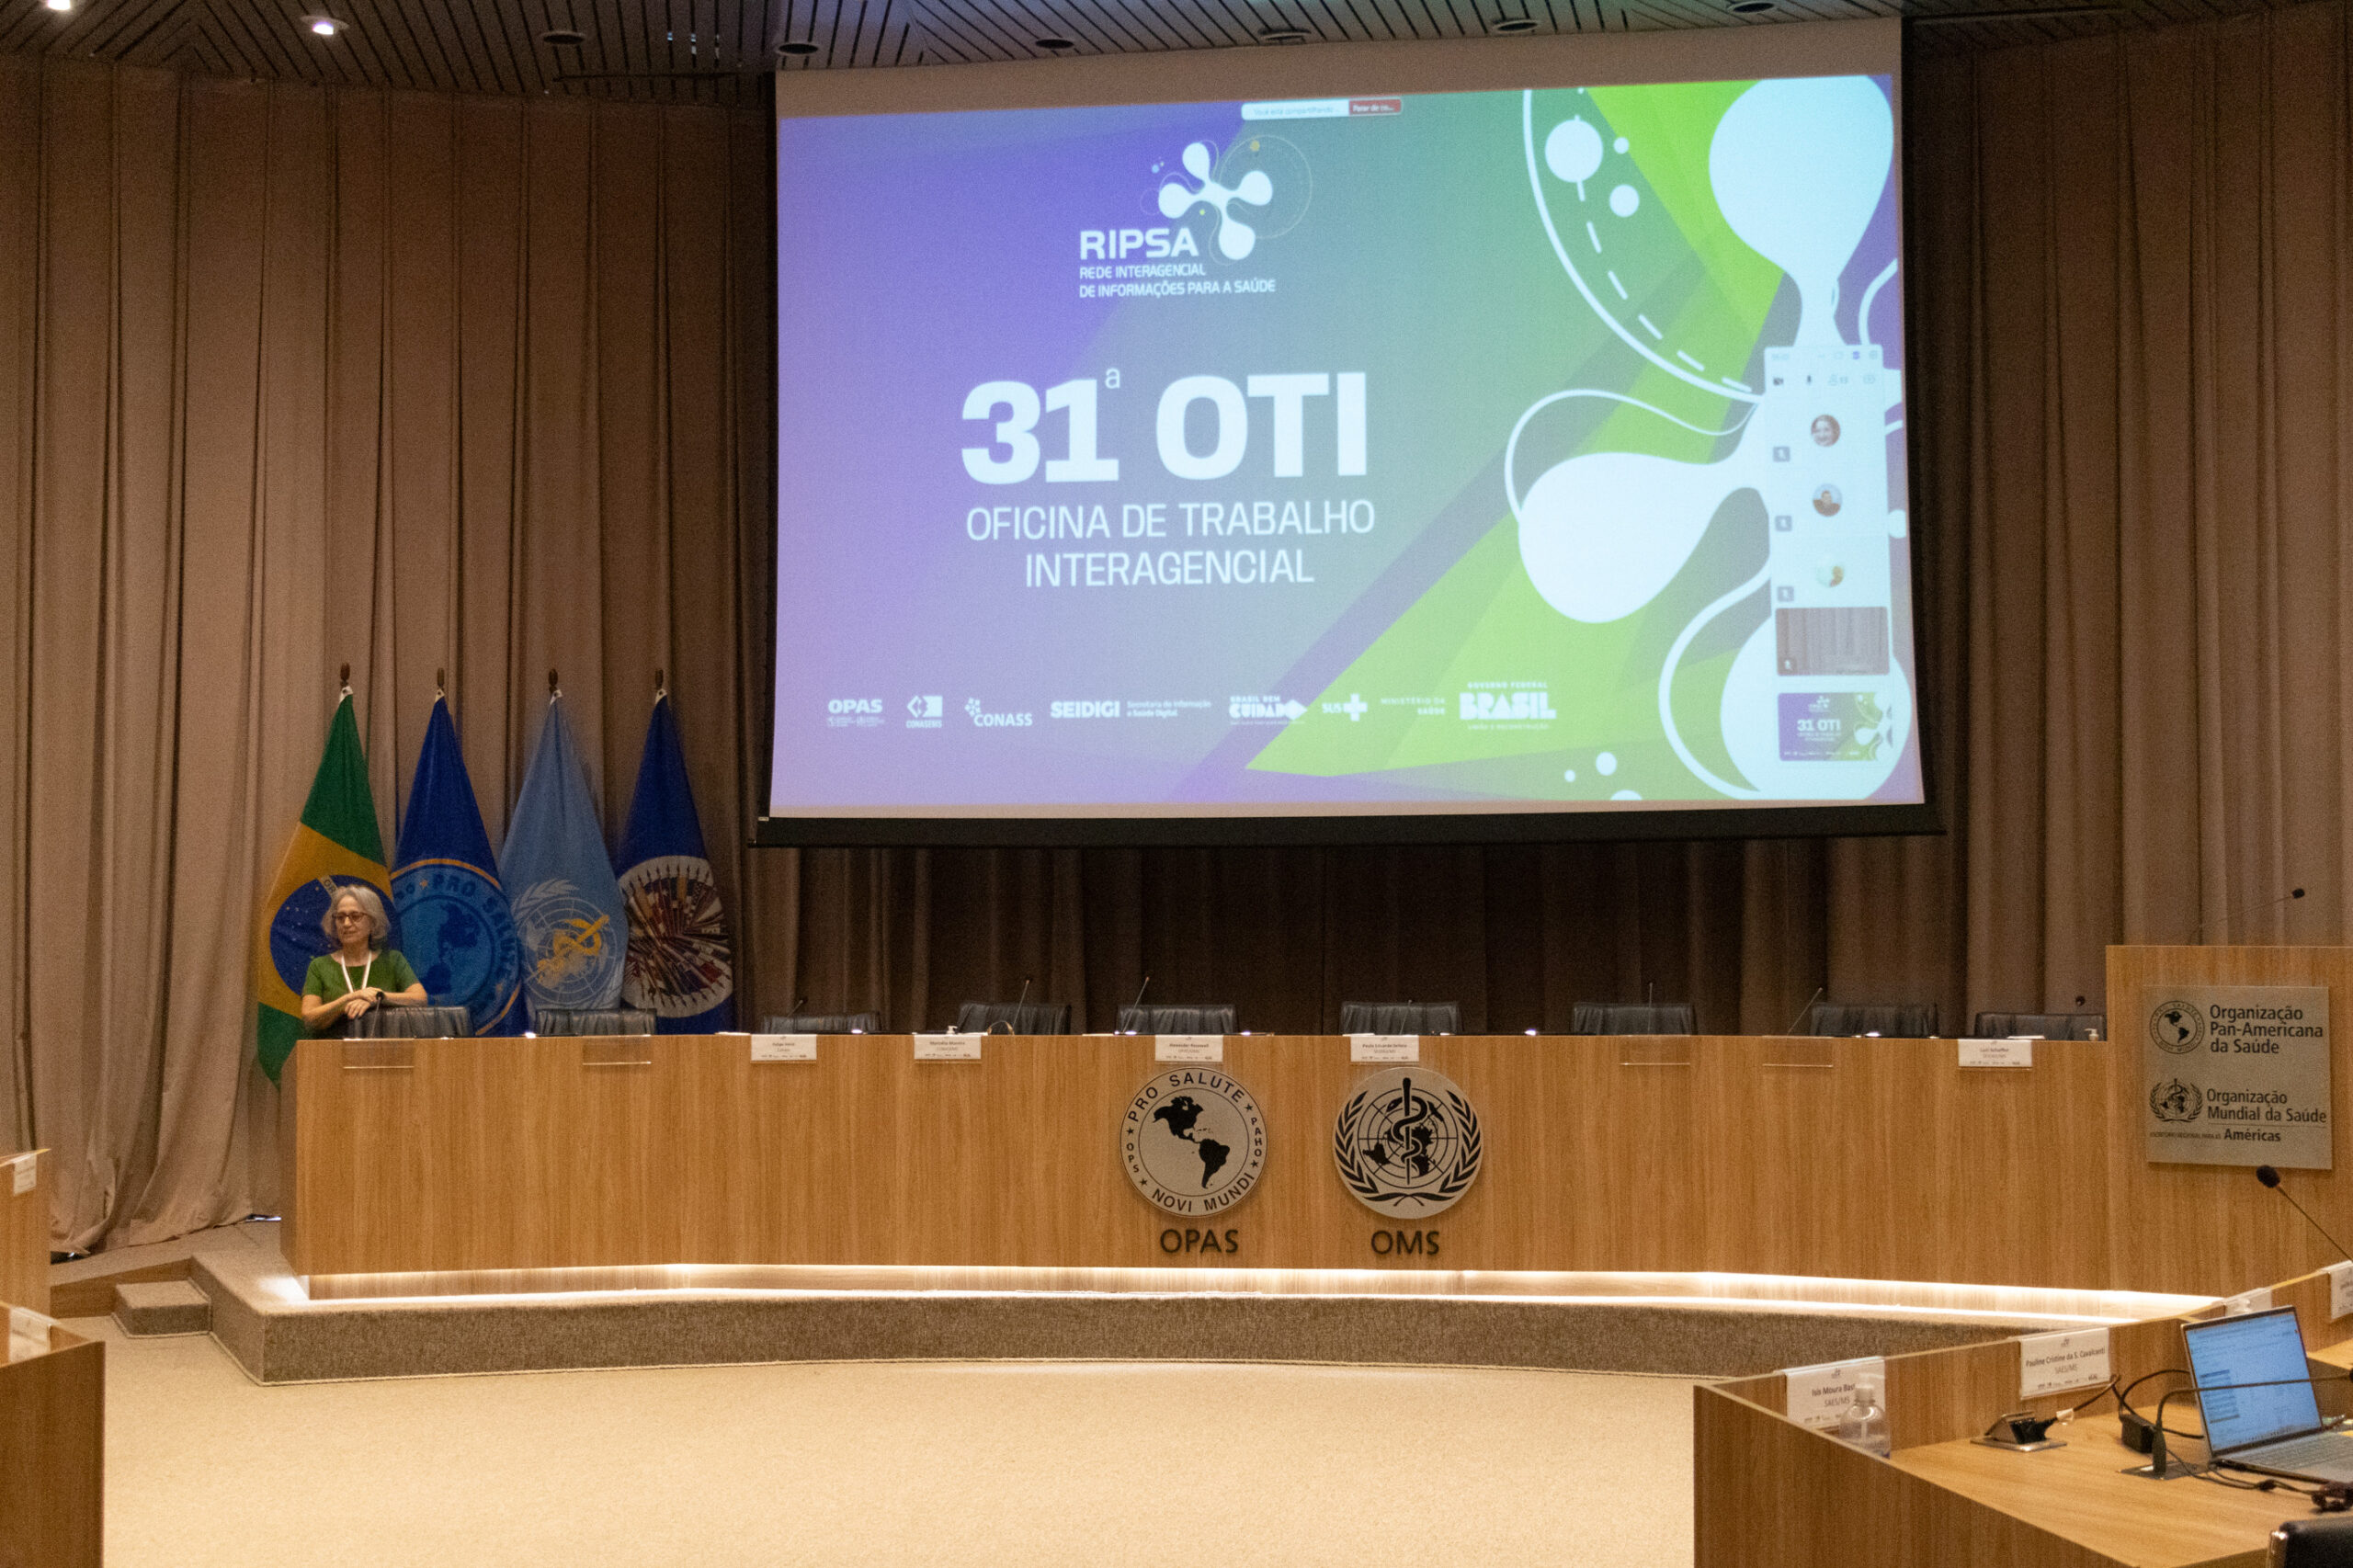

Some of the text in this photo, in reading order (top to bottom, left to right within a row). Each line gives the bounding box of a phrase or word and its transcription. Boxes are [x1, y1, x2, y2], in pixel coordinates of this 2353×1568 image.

[1080, 227, 1199, 260] RIPSA
[1079, 263, 1206, 279] REDE INTERAGENCIAL
[1079, 277, 1276, 299] DE INFORMAÇÕES PARA A SAÚDE
[1155, 371, 1367, 480] OTI
[966, 499, 1376, 540] OFICINA DE TRABALHO
[1026, 549, 1315, 587] INTERAGENCIAL
[828, 699, 883, 713] OPAS
[1051, 700, 1120, 718] SEIDIGI
[1322, 702, 1342, 713] SUS
[1460, 691, 1557, 720] BRASIL
[974, 713, 1033, 727] CONASS
[1816, 719, 1841, 732] OTI
[433, 874, 476, 897] PRO
[2210, 1005, 2303, 1024] Organização
[2210, 1021, 2324, 1038] Pan-Americana
[2210, 1038, 2229, 1053] da
[2234, 1038, 2279, 1054] Saúde
[1128, 1072, 1245, 1122] PRO SALUTE
[2207, 1088, 2288, 1108] Organização
[2208, 1106, 2327, 1123] Mundial da Saúde
[1250, 1117, 1263, 1158] PAHO
[2224, 1128, 2280, 1142] Américas
[1126, 1142, 1141, 1173] OPS
[1152, 1173, 1256, 1213] NOVI MUNDI
[1160, 1228, 1239, 1254] OPAS
[1370, 1231, 1440, 1256] OMS
[2080, 1346, 2106, 1358] Cavalcanti
[1823, 1385, 1843, 1395] Moura
